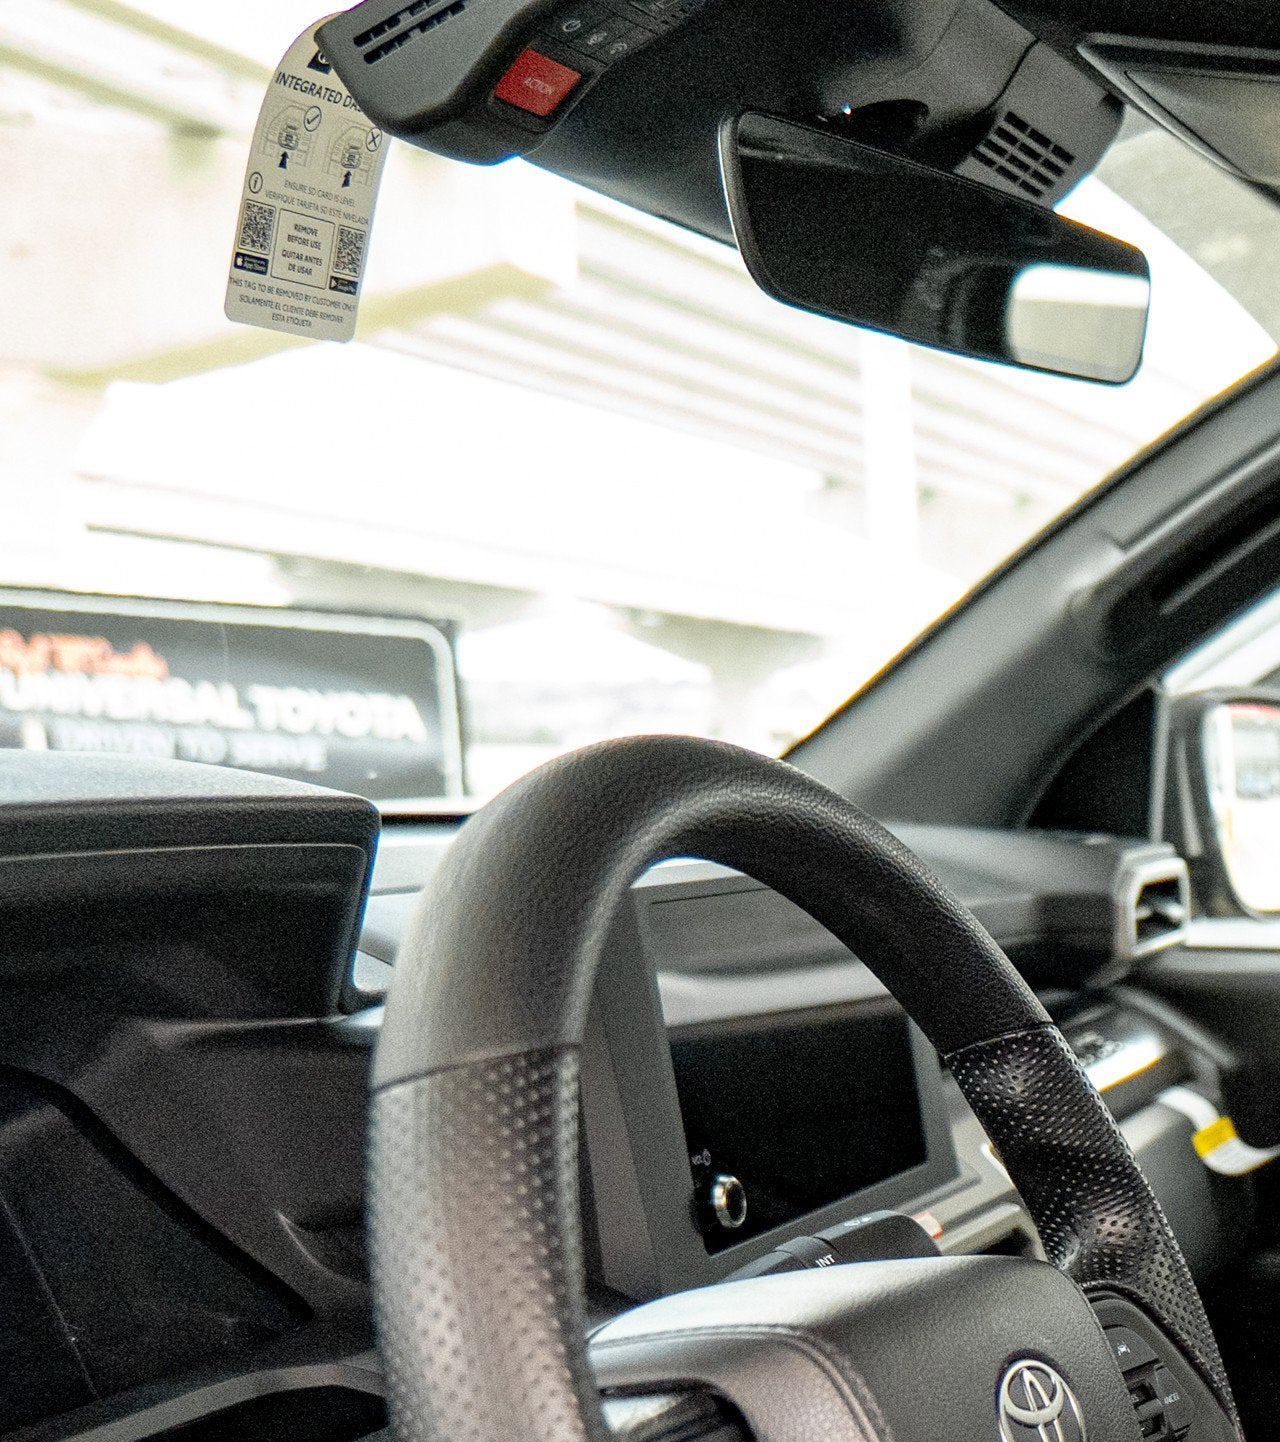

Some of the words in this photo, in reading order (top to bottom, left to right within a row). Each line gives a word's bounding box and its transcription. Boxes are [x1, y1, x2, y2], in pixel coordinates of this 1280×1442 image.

[275, 71, 343, 104] INTEGRATED
[343, 95, 361, 112] DA
[284, 180, 308, 193] ENSURE
[318, 189, 333, 201] CARD
[339, 195, 356, 208] LEVEL
[294, 223, 318, 237] REMOVE
[287, 234, 310, 248] BEFORE
[310, 240, 322, 250] USE
[281, 249, 304, 261] QUITAR
[304, 255, 323, 266] ANTES
[288, 263, 296, 272] DE
[297, 266, 313, 276] USAR
[229, 277, 243, 288] THIS
[244, 280, 257, 291] TAG
[258, 283, 267, 293] TO
[267, 285, 275, 295] BE
[275, 287, 304, 301] REMOVED
[312, 296, 341, 310] CUSTOMER
[271, 312, 286, 322] ESTA
[286, 315, 312, 327] ETIQUETA
[249, 683, 429, 744] TOYOTA
[815, 1254, 836, 1268] INT
